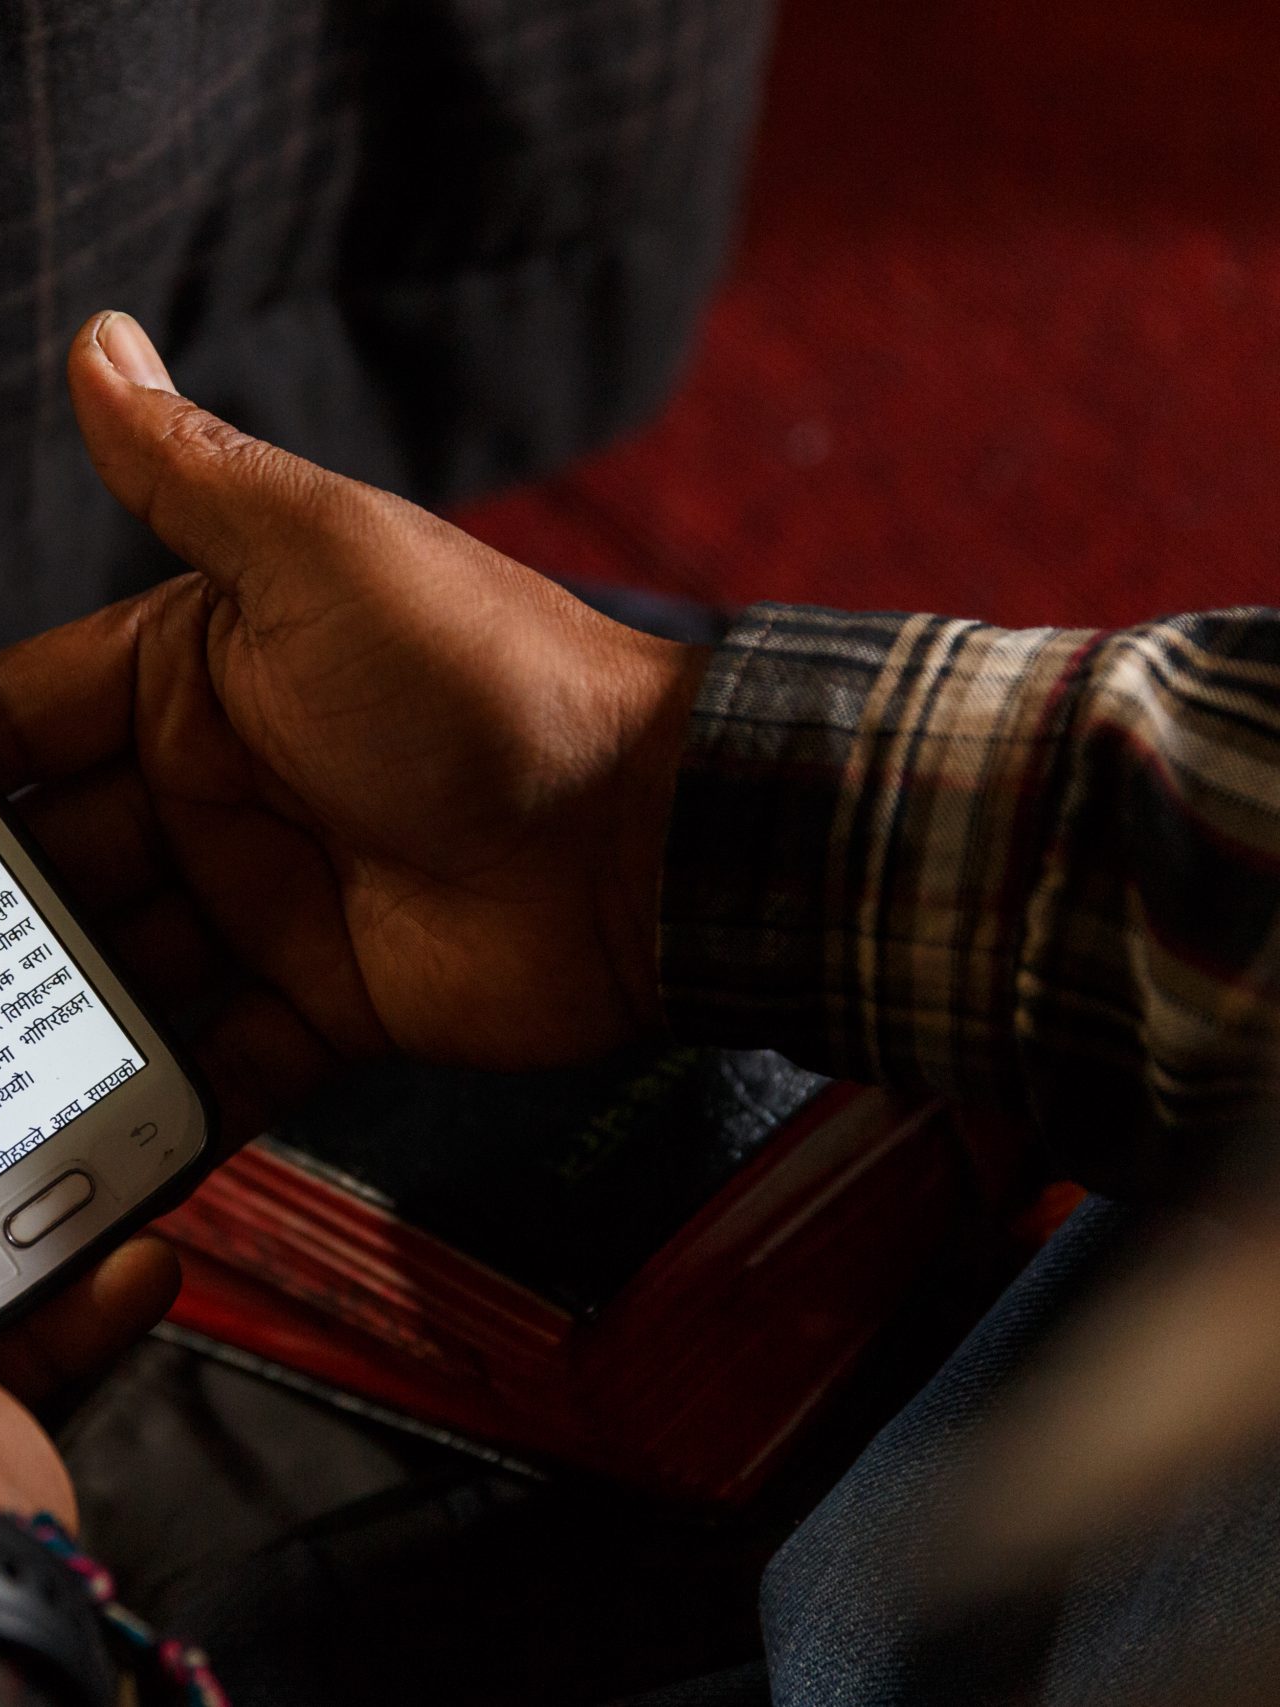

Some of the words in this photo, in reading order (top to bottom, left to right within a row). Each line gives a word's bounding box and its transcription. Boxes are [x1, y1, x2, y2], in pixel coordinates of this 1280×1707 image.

[17, 942, 53, 970] बस।
[0, 965, 73, 1024] तिमीहरूका
[18, 990, 94, 1045] भोगिरहेछन्
